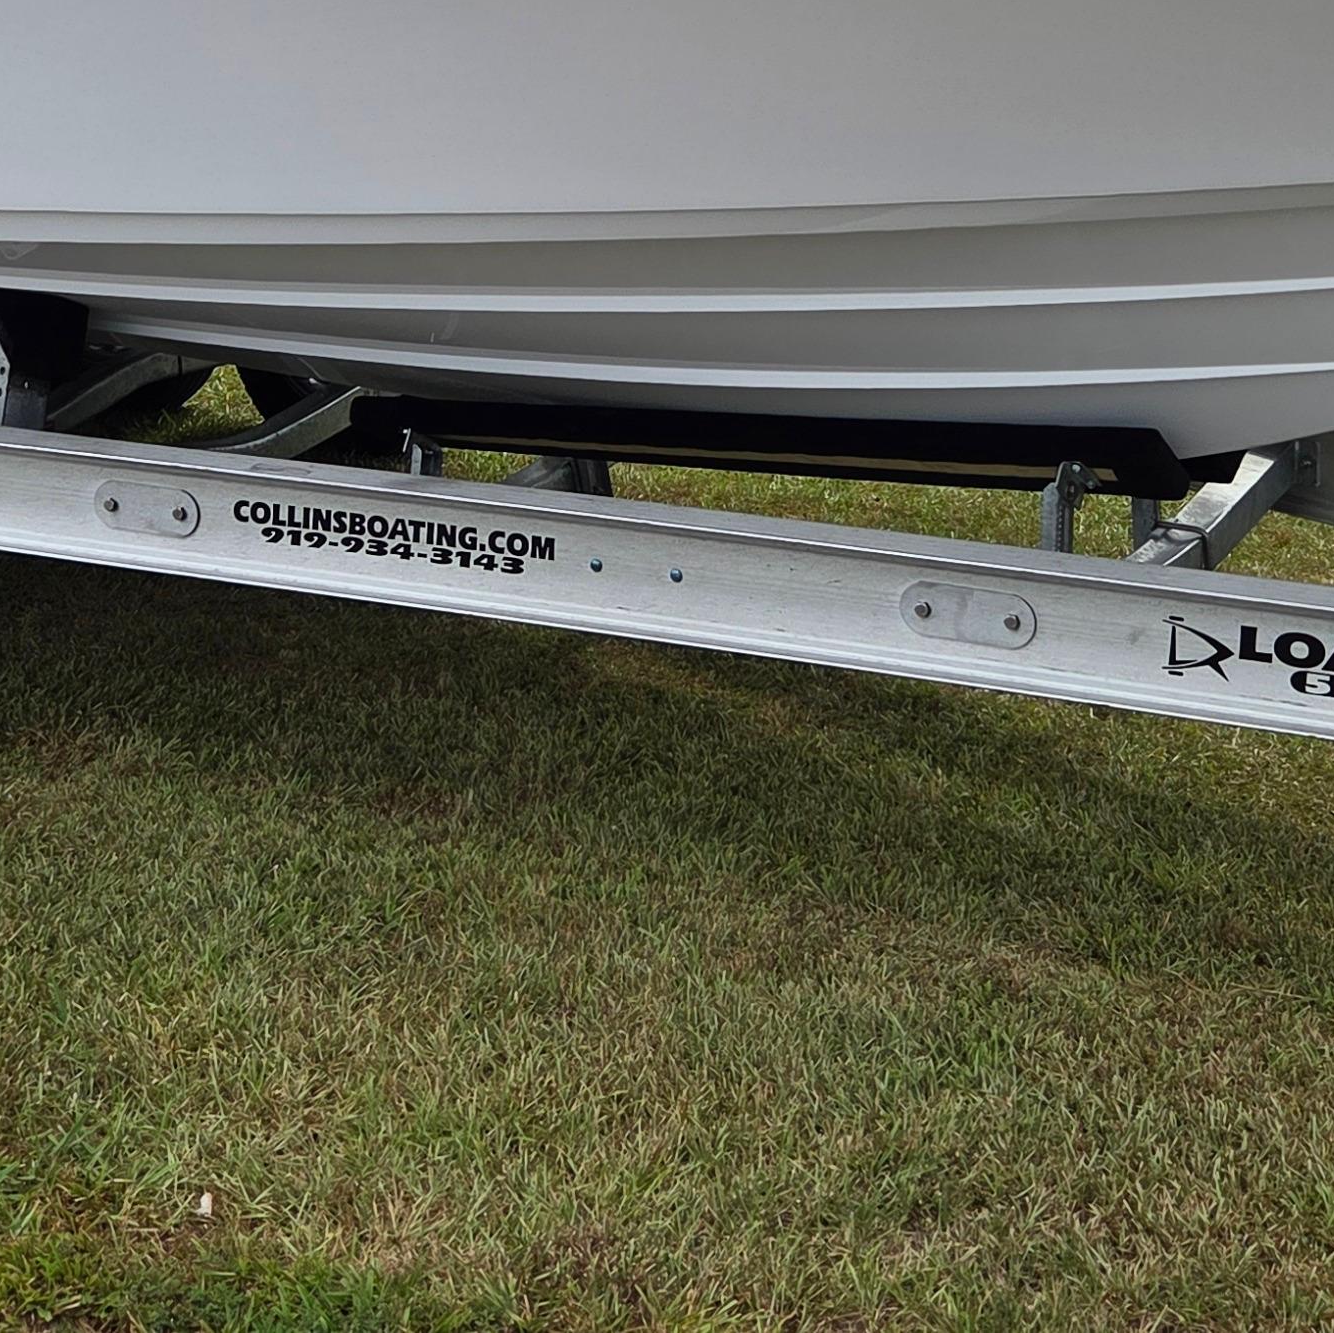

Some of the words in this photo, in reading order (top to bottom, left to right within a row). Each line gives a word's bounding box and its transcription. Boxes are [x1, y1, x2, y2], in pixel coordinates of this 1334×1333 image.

[233, 500, 556, 561] COLLINSBOATING.COM
[261, 527, 525, 575] 919-934-3143
[1304, 672, 1331, 697] 5
